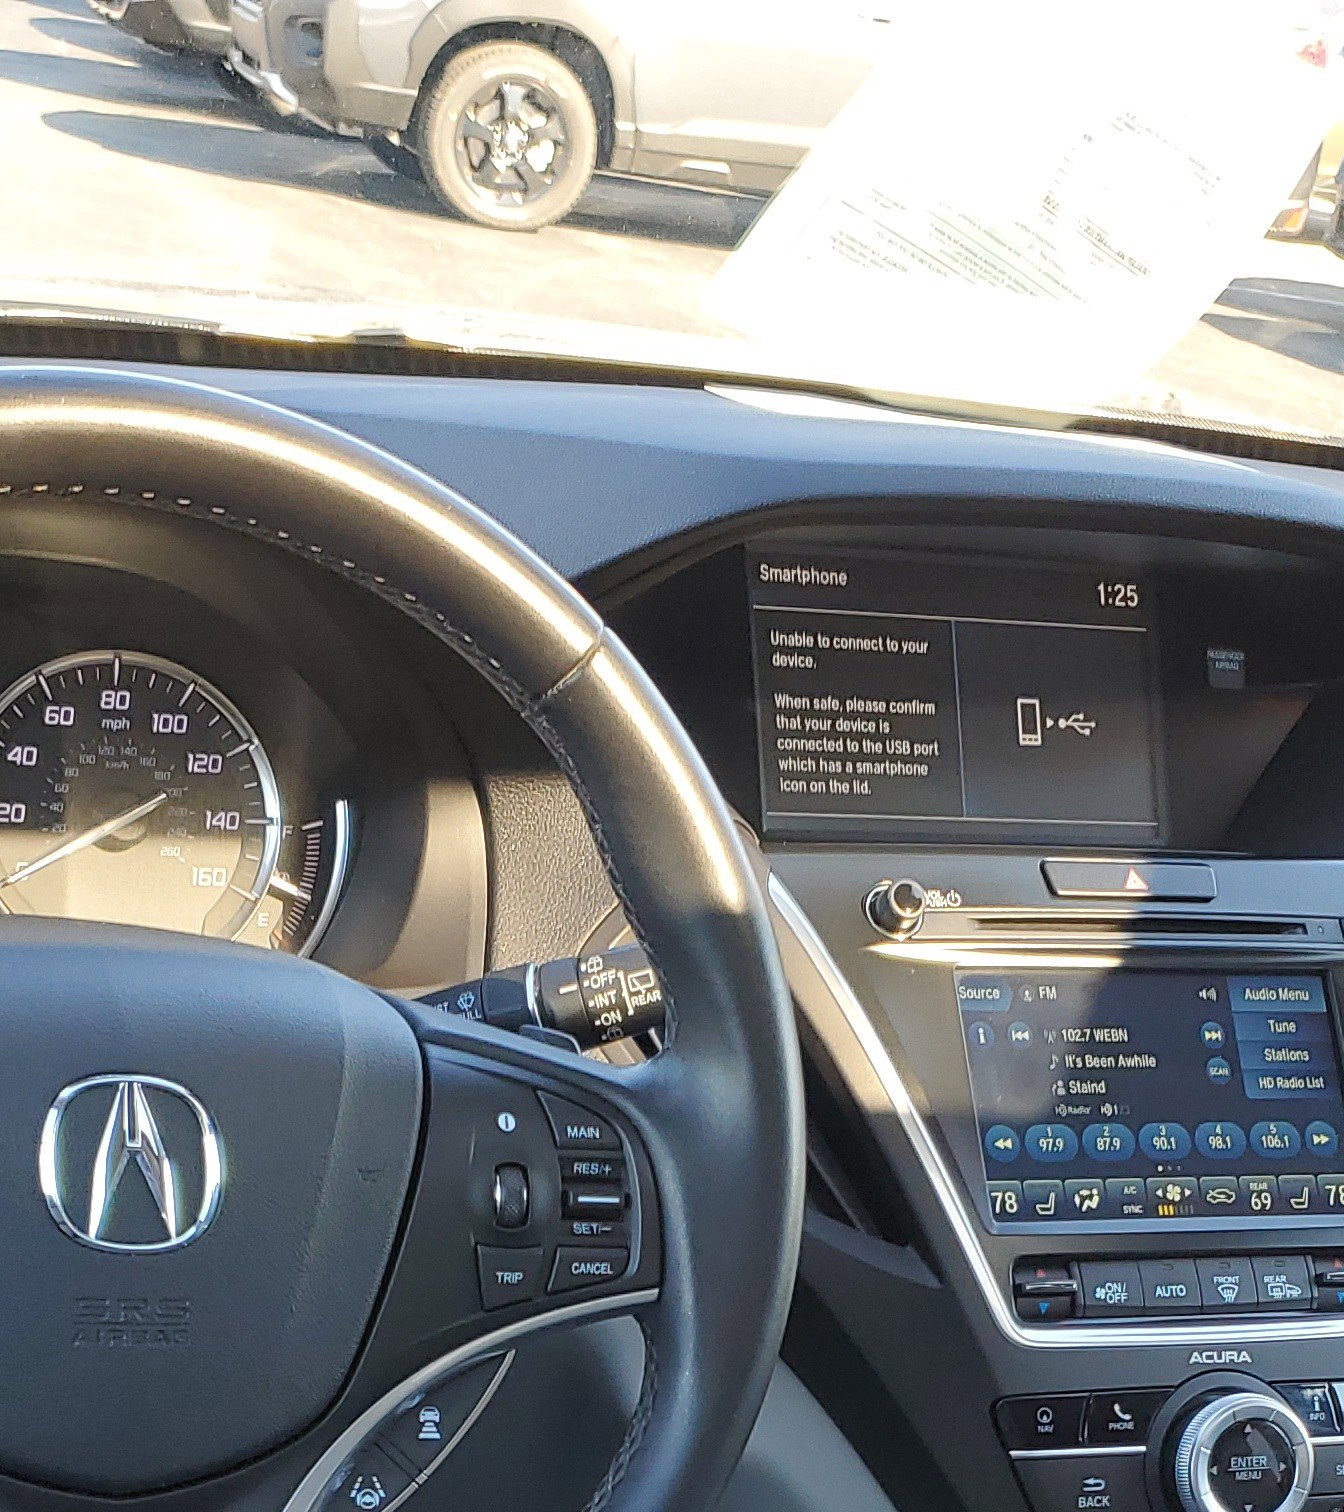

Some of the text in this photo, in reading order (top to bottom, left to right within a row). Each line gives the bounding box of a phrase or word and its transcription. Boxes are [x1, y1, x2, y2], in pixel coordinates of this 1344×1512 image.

[759, 563, 848, 587] Smartphone
[1097, 581, 1139, 608] 1:25
[770, 629, 929, 655] Unable to connect to your
[772, 651, 817, 669] device.
[99, 689, 131, 711] 80
[773, 692, 936, 716] When safe, please confirm
[44, 705, 76, 727] 60
[151, 713, 189, 734] 100
[775, 713, 890, 734] that your device is
[101, 716, 130, 732] mph
[776, 736, 939, 757] connected to the USB port
[6, 745, 38, 767] 40
[78, 754, 96, 765] 100
[186, 752, 223, 774] 120
[778, 756, 929, 778] which has a smartphone
[779, 777, 872, 796] icon on the lid.
[205, 809, 240, 831] 140
[282, 825, 294, 838] F
[160, 846, 181, 857] 260
[191, 865, 228, 888] 160
[257, 912, 269, 928] E
[590, 969, 618, 990] OFF
[594, 990, 618, 1009] INT
[631, 990, 662, 1008] REAR
[958, 985, 1000, 1000] Source
[1038, 985, 1057, 1000] FM
[1244, 987, 1310, 1001] Audio Menu
[600, 1009, 623, 1026] ON
[1267, 1019, 1297, 1033] Tune
[1061, 1027, 1129, 1043] 102.7 WEBN
[1064, 1054, 1157, 1069] It's Been Awhile
[1263, 1047, 1310, 1062] Stations
[1068, 1080, 1106, 1095] Staind
[1258, 1075, 1325, 1089] HD Radio List
[566, 1124, 600, 1139] MAIN
[1046, 1126, 1052, 1137] 1
[1103, 1126, 1110, 1136] 2
[1159, 1125, 1166, 1136] 3
[1215, 1124, 1222, 1135] 4
[1269, 1123, 1277, 1134] 5
[1038, 1139, 1064, 1152] 97.9
[1096, 1137, 1121, 1151] 87.9
[1152, 1137, 1177, 1151] 90.1
[1208, 1136, 1232, 1150] 98.1
[1261, 1135, 1290, 1148] 106.1
[1249, 1181, 1269, 1191] REAR
[990, 1191, 1019, 1214] 78
[1250, 1192, 1271, 1211] 69
[1122, 1204, 1144, 1215] SYNC
[571, 1262, 614, 1275] CANCEL
[495, 1271, 524, 1284] TRIP
[1213, 1275, 1240, 1285] FRONT
[1263, 1274, 1287, 1284] REAR
[1105, 1281, 1127, 1294] ON/
[1155, 1284, 1187, 1298] AUTO
[1105, 1292, 1129, 1304] OFF
[1188, 1350, 1253, 1365] ACURA
[1037, 1424, 1054, 1434] NAV
[1108, 1421, 1135, 1431] PHONE
[1230, 1455, 1267, 1469] ENTER
[1234, 1470, 1262, 1481] MENU
[1077, 1496, 1111, 1509] BACK
